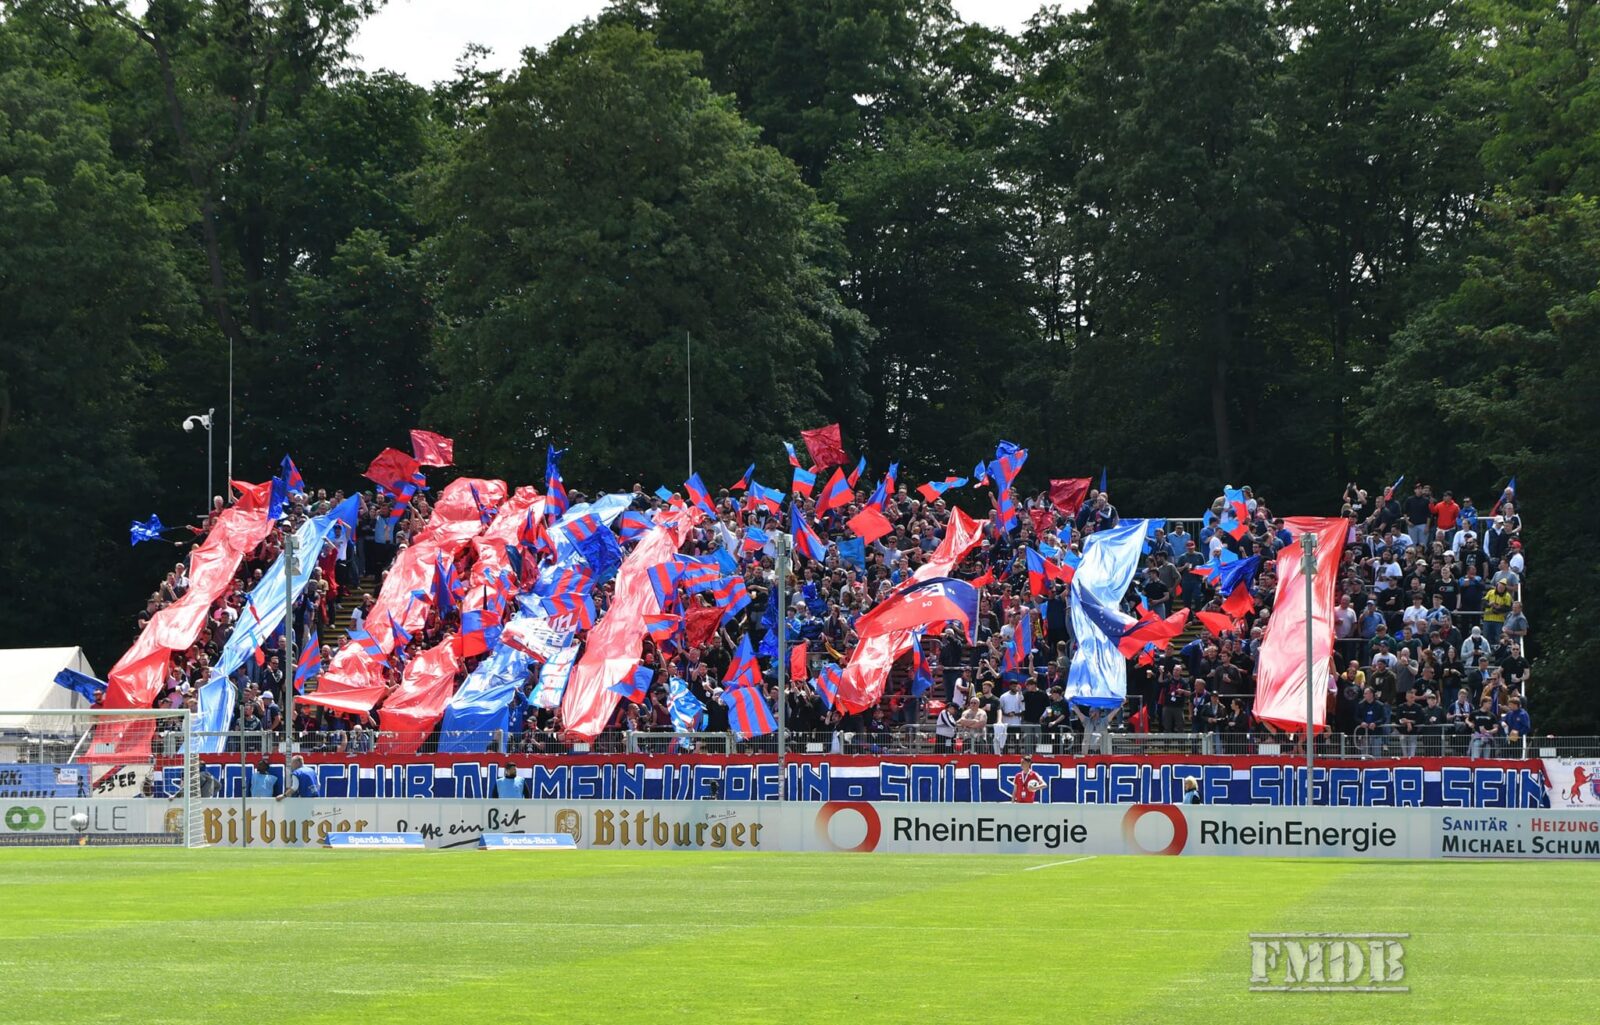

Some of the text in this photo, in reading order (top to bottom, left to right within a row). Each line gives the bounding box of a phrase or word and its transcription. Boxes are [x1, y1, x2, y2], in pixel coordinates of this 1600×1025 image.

[532, 763, 646, 800] MEIN
[1250, 765, 1424, 807] SIEGER
[1441, 766, 1542, 808] SEIN
[53, 806, 127, 831] EULE
[449, 819, 484, 836] ein
[487, 807, 526, 830] Bit
[592, 808, 764, 848] Bitburger
[1442, 816, 1508, 831] SANITÄR
[1531, 818, 1599, 832] HEIZUNG
[348, 835, 406, 845] Sparda-Bank
[502, 836, 557, 847] Sparda-Bank
[893, 817, 1088, 848] RheinEnergie
[1200, 820, 1397, 851] RheinEnergie
[1442, 835, 1526, 853] MICHAEL
